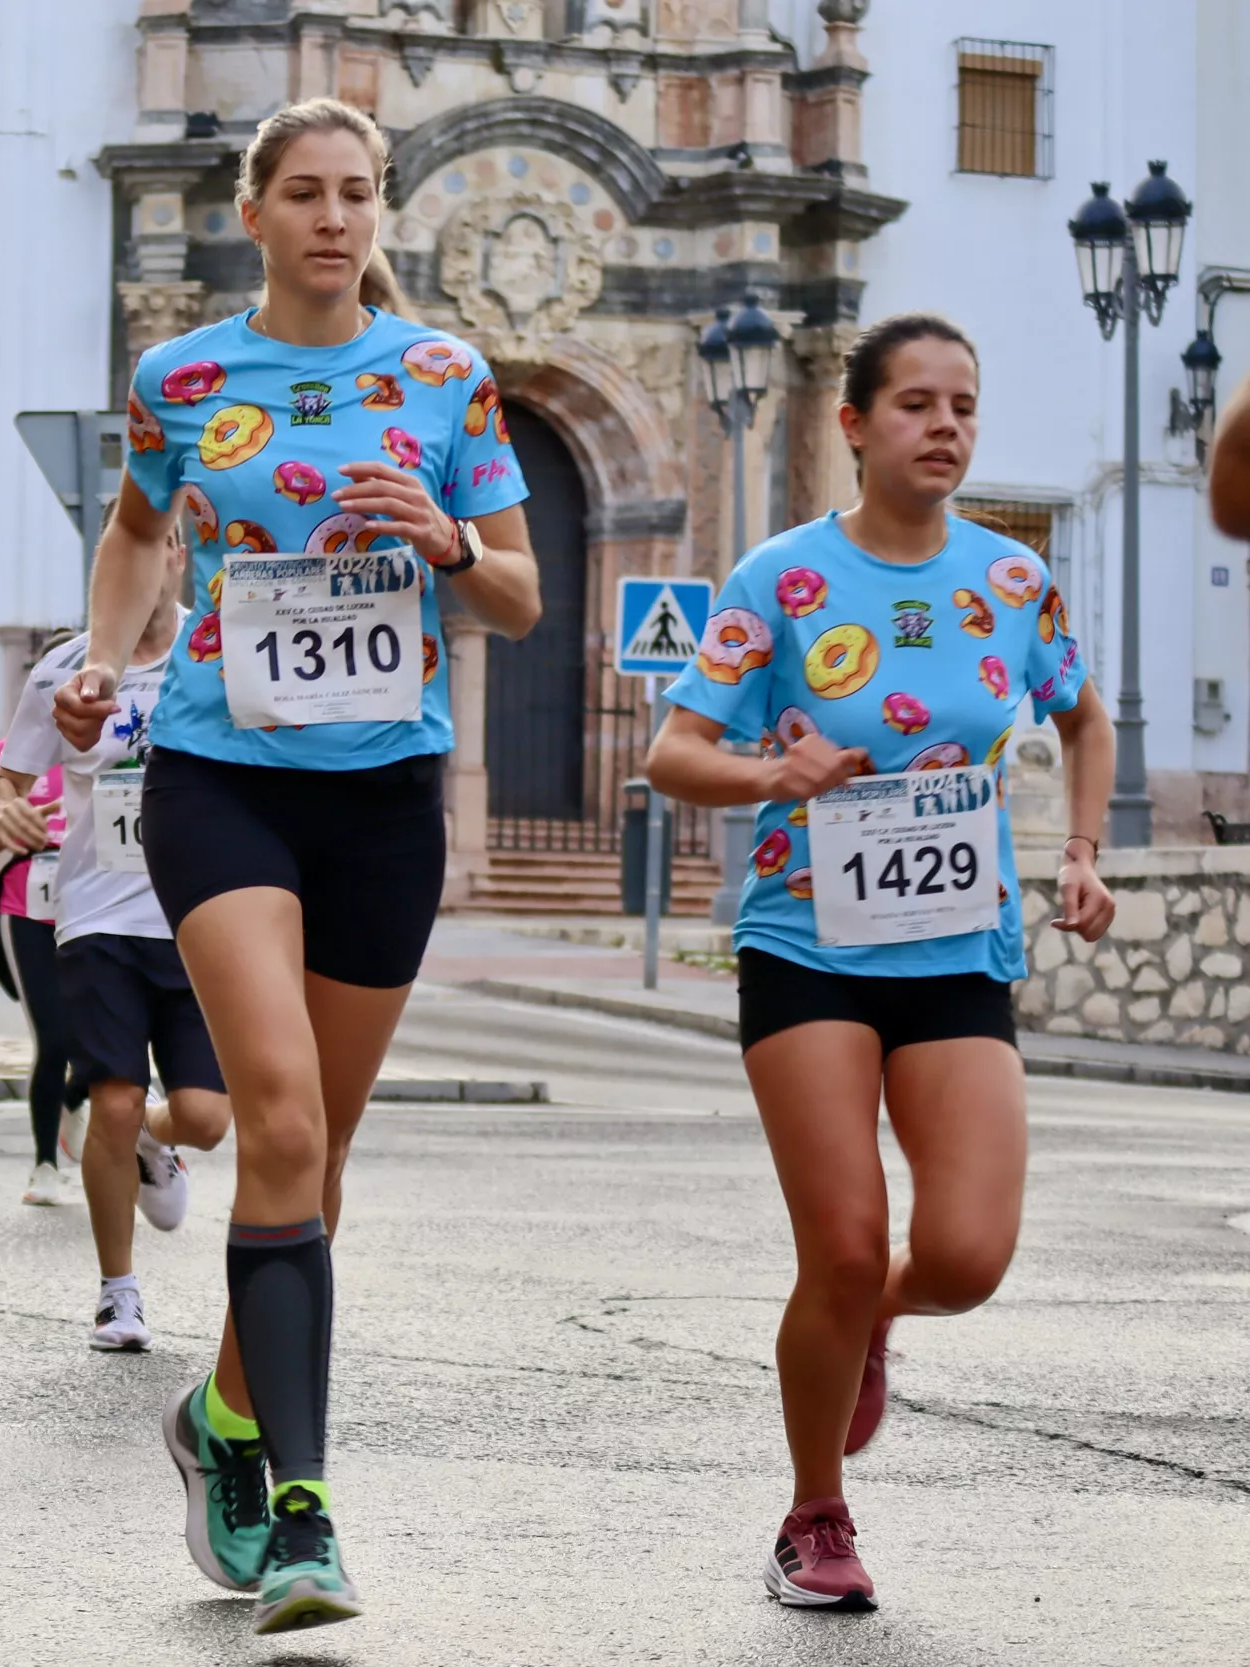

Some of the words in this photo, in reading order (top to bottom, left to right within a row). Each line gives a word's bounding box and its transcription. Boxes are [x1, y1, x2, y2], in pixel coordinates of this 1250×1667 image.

[328, 557, 377, 575] 2024
[255, 623, 401, 682] 1310
[843, 842, 978, 901] 1429
